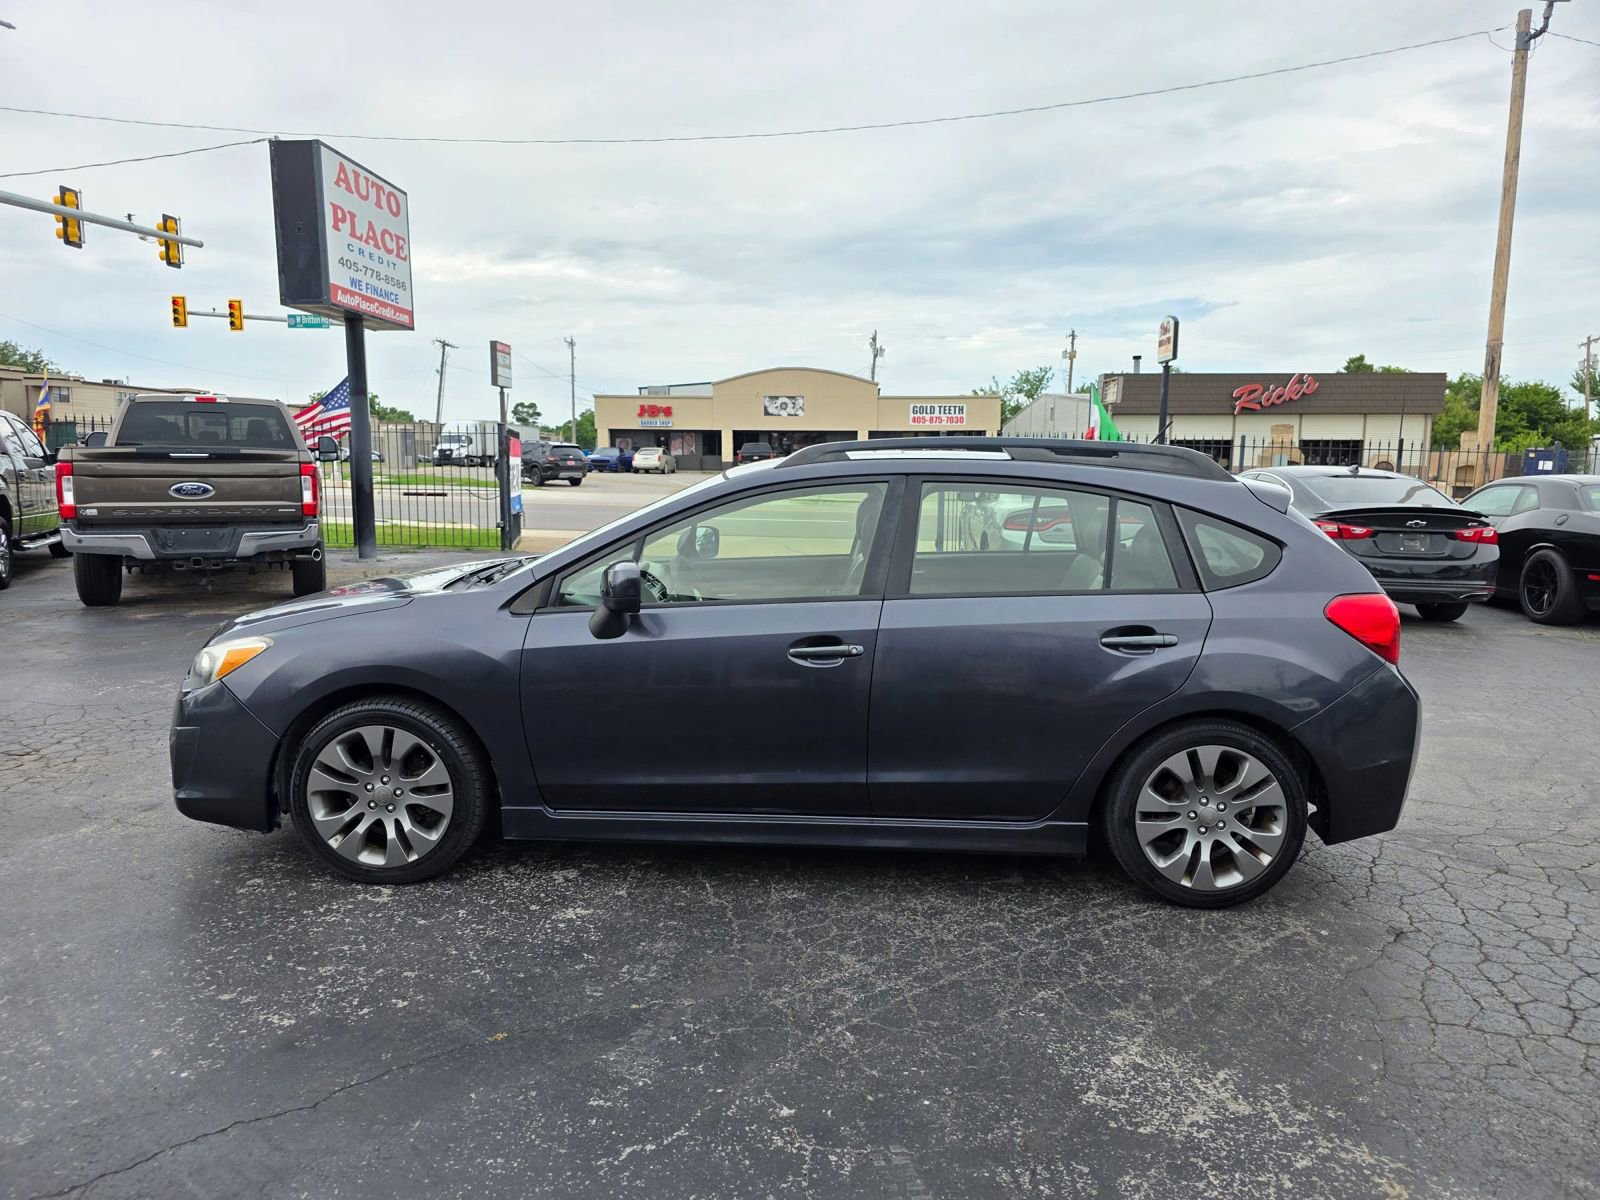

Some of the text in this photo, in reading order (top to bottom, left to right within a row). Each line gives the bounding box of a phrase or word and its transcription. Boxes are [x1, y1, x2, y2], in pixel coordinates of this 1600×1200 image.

[334, 161, 401, 218] AUTO
[330, 201, 408, 262] PLACE
[347, 243, 397, 271] CREDIT
[338, 256, 407, 291] 405-778-8586
[349, 276, 400, 304] WE FINANCE
[296, 315, 302, 324] W
[302, 315, 321, 324] Britton
[337, 290, 410, 324] AutoPlaceCredit.com
[1232, 373, 1320, 416] Rick's
[911, 416, 965, 424] 405-875-7030
[912, 405, 964, 415] GOLD TEETH
[180, 485, 204, 495] Ford
